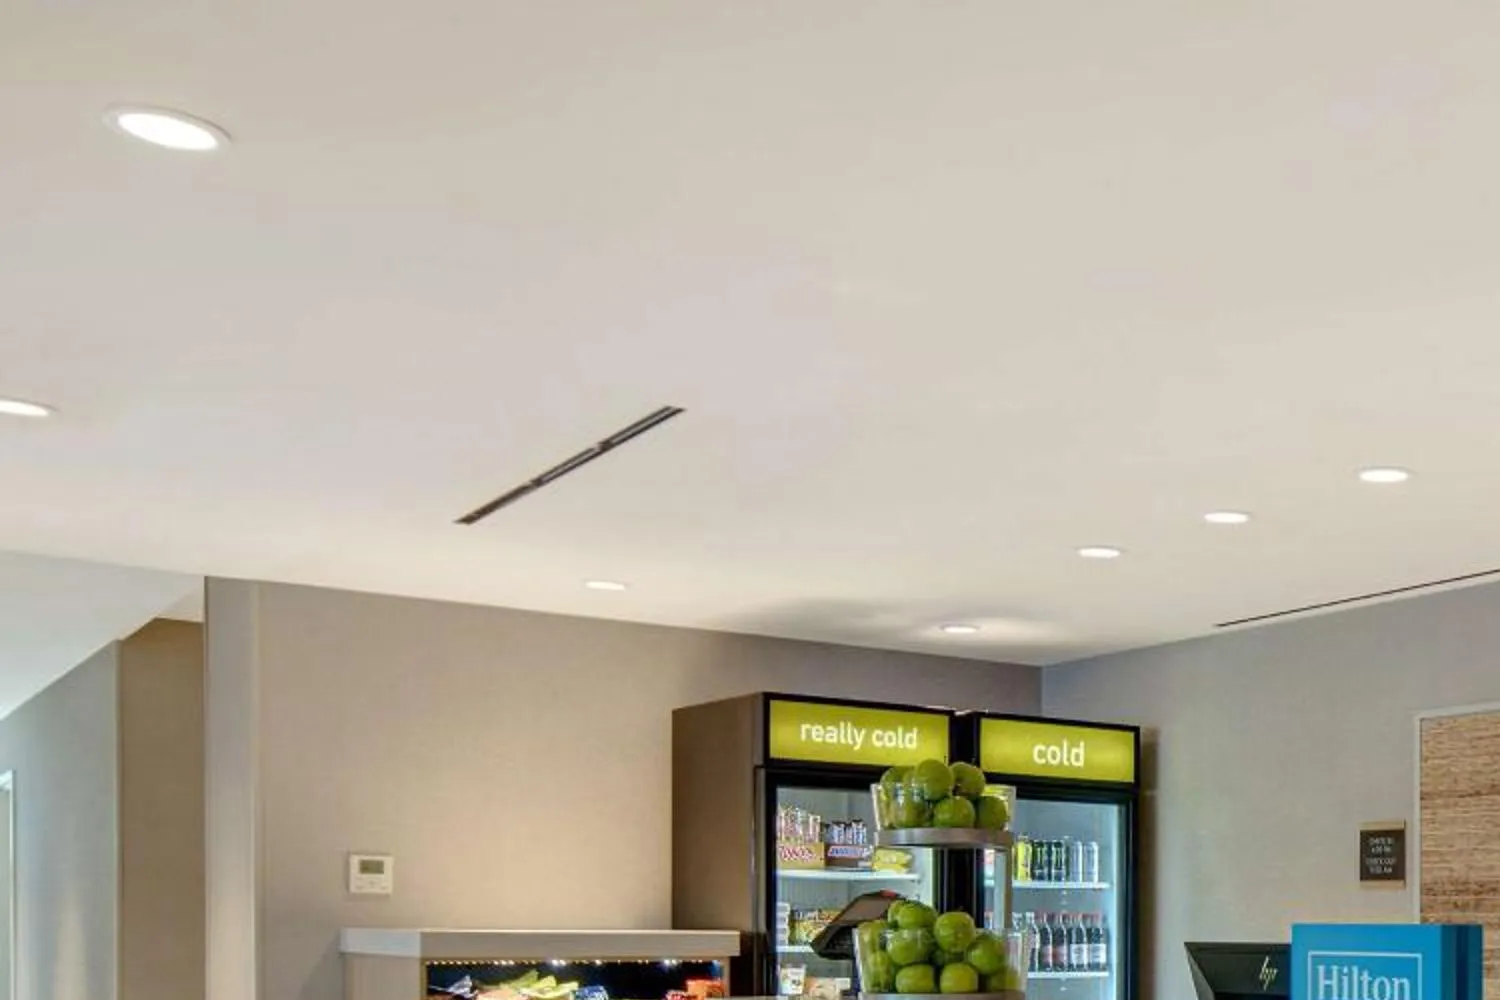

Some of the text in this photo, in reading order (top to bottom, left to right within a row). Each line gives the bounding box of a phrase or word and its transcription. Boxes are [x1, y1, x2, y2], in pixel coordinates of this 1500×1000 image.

[800, 721, 918, 751] really cold
[1033, 738, 1085, 767] cold
[1259, 955, 1278, 991] hp
